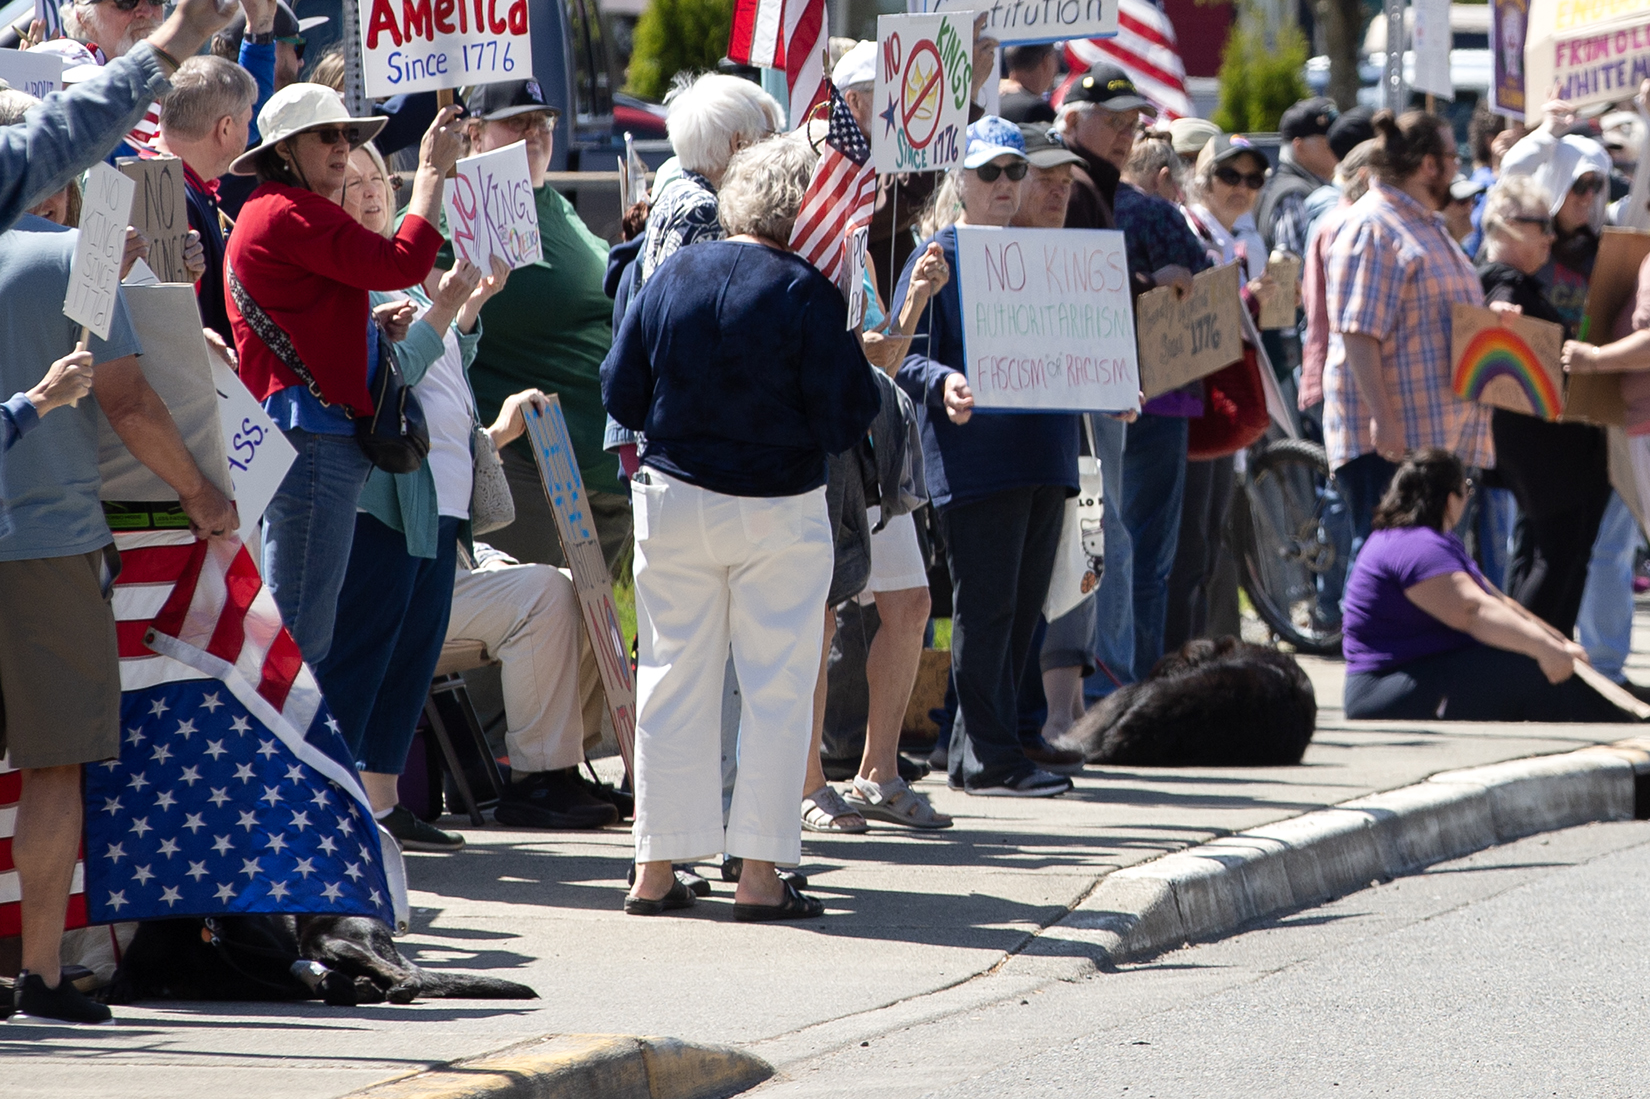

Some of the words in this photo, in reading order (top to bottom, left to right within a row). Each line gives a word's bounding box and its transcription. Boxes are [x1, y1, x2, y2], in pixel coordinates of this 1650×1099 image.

[387, 50, 448, 85] Since
[462, 40, 515, 73] 1776
[883, 31, 901, 85] NO
[936, 15, 972, 111] KINGS
[1555, 58, 1627, 101] WHITE
[895, 126, 928, 170] SINCE
[933, 123, 959, 165] 1776
[100, 170, 120, 212] NO
[144, 163, 175, 232] NO
[476, 164, 538, 270] KINGS
[84, 204, 125, 266] KINGS
[985, 241, 1027, 292] NO
[1043, 244, 1126, 294] KINGS
[977, 353, 1049, 393] FASCISM
[1065, 353, 1134, 389] RACISM
[587, 593, 632, 693] NO
